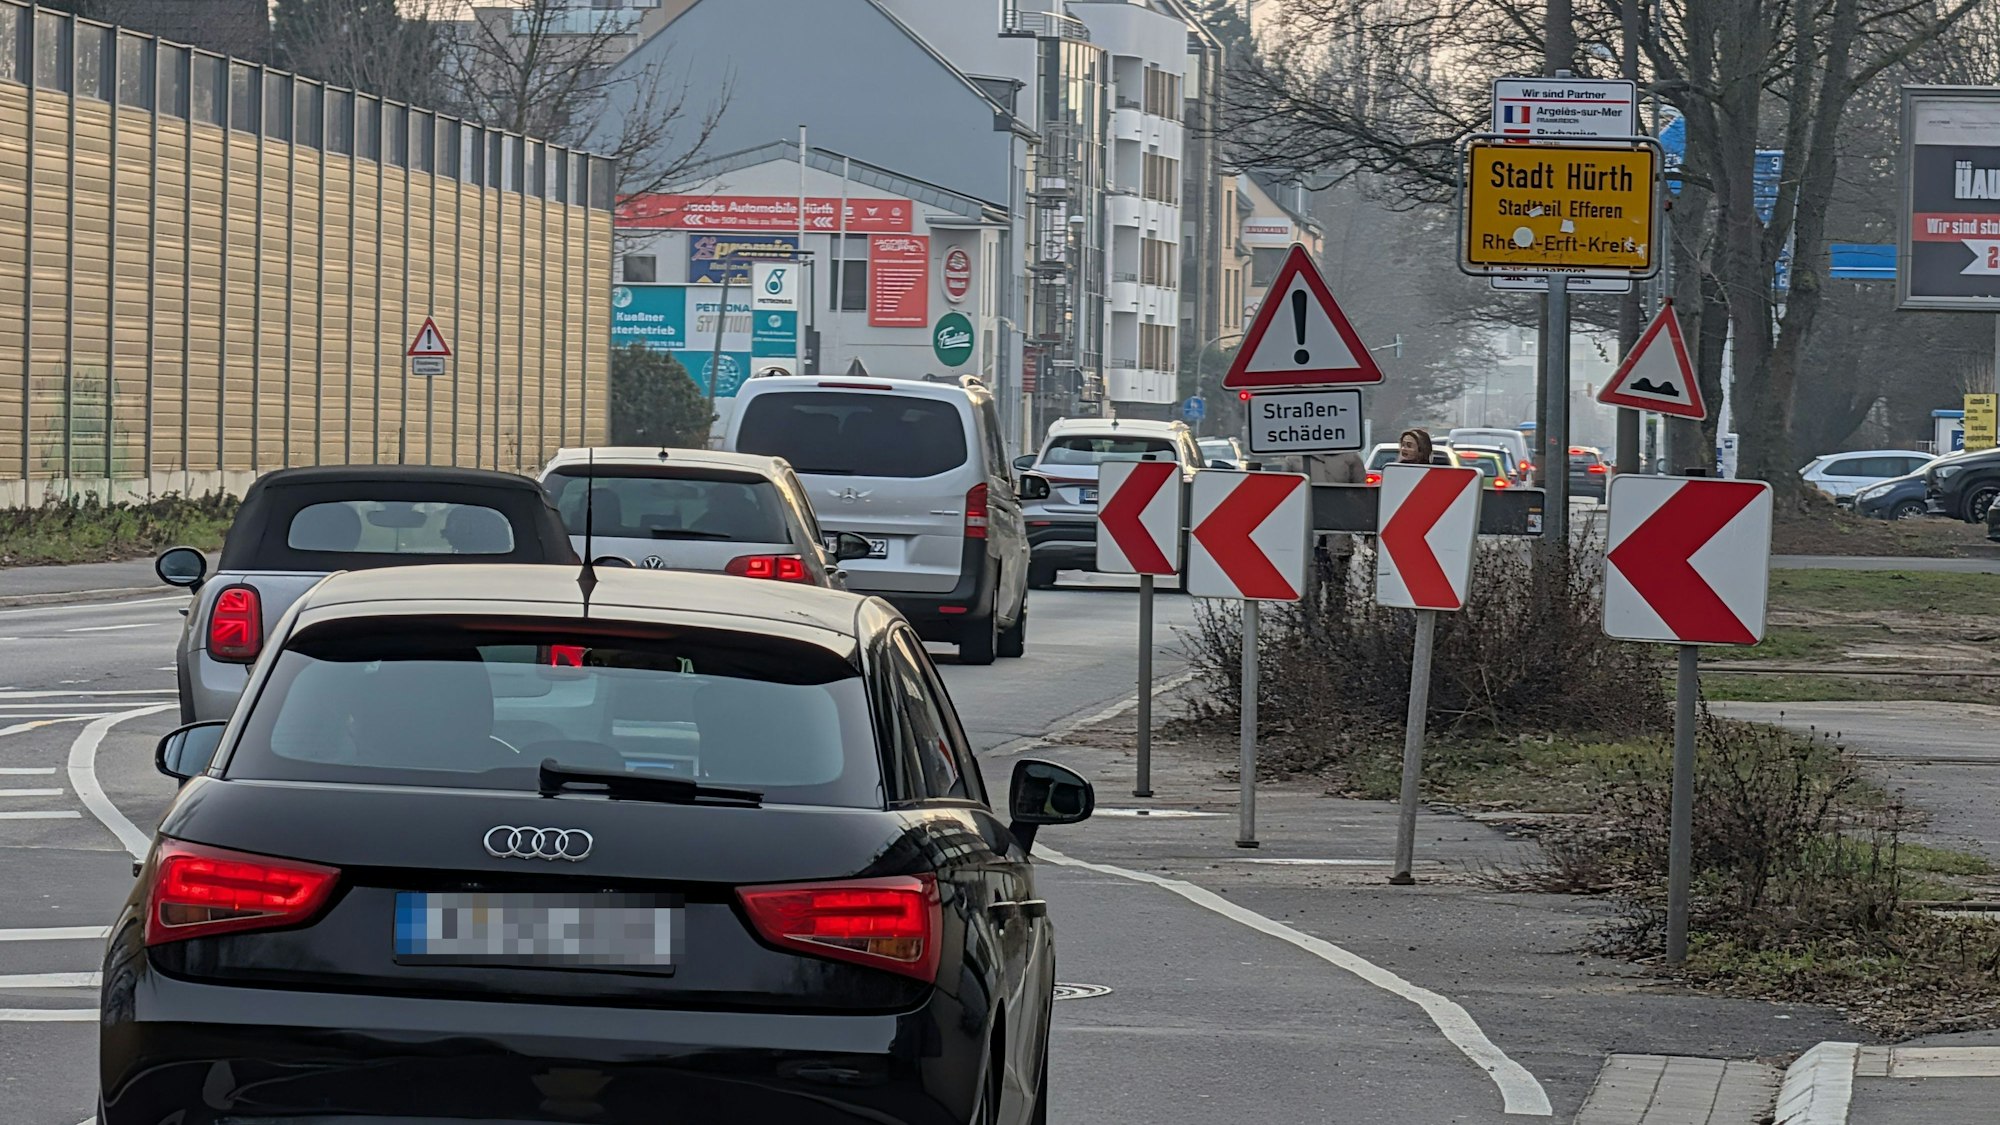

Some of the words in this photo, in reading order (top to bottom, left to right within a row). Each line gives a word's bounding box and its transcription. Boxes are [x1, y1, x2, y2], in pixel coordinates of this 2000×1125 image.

[1522, 89, 1540, 98] Wir
[1542, 89, 1564, 98] sind
[1567, 90, 1607, 99] Partner
[1490, 160, 1554, 189] Stadt
[1567, 162, 1633, 192] Hürth
[683, 200, 726, 212] Jacobs
[728, 201, 798, 214] Automobile
[1498, 198, 1562, 217] Stadtteil
[1570, 200, 1623, 219] Efferen
[1926, 218, 1950, 234] Wir
[1952, 218, 1978, 234] sind
[1980, 219, 2000, 235] sto
[695, 303, 751, 313] PETONA
[1263, 401, 1348, 419] Straßen-
[1267, 424, 1345, 443] schäden
